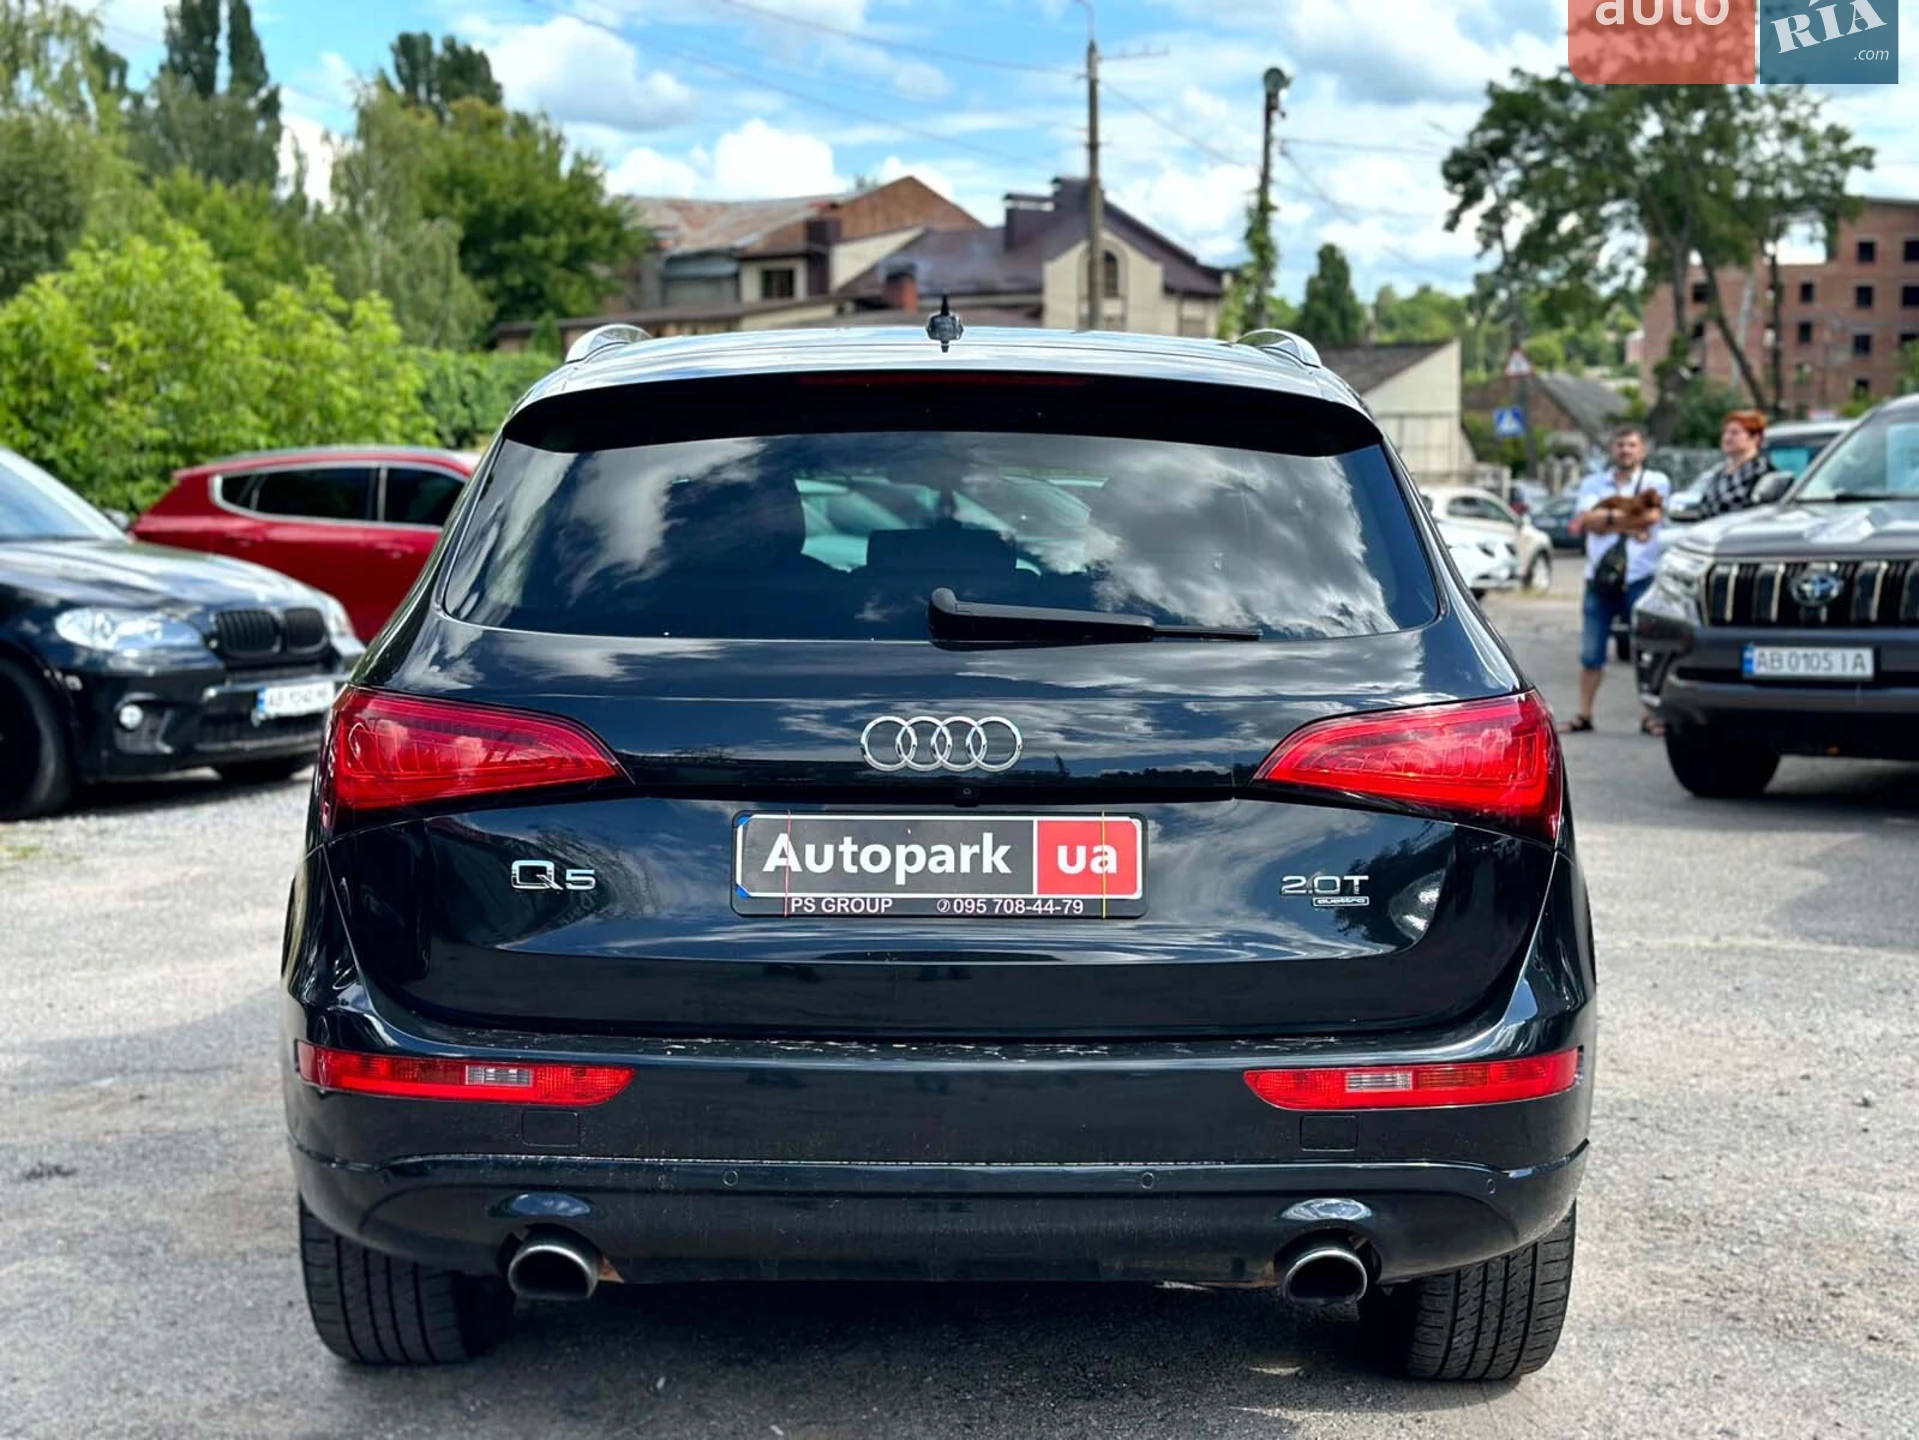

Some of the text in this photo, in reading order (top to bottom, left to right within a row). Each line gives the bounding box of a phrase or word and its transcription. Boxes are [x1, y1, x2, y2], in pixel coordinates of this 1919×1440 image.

[1757, 651, 1783, 671] AB
[1787, 651, 1833, 672] 0105
[762, 832, 1118, 886] Autopark ua
[511, 860, 596, 890] Q5
[1281, 875, 1369, 895] 2.0T
[791, 898, 893, 913] PS GROUP
[953, 899, 1084, 914] 095 708-44-79
